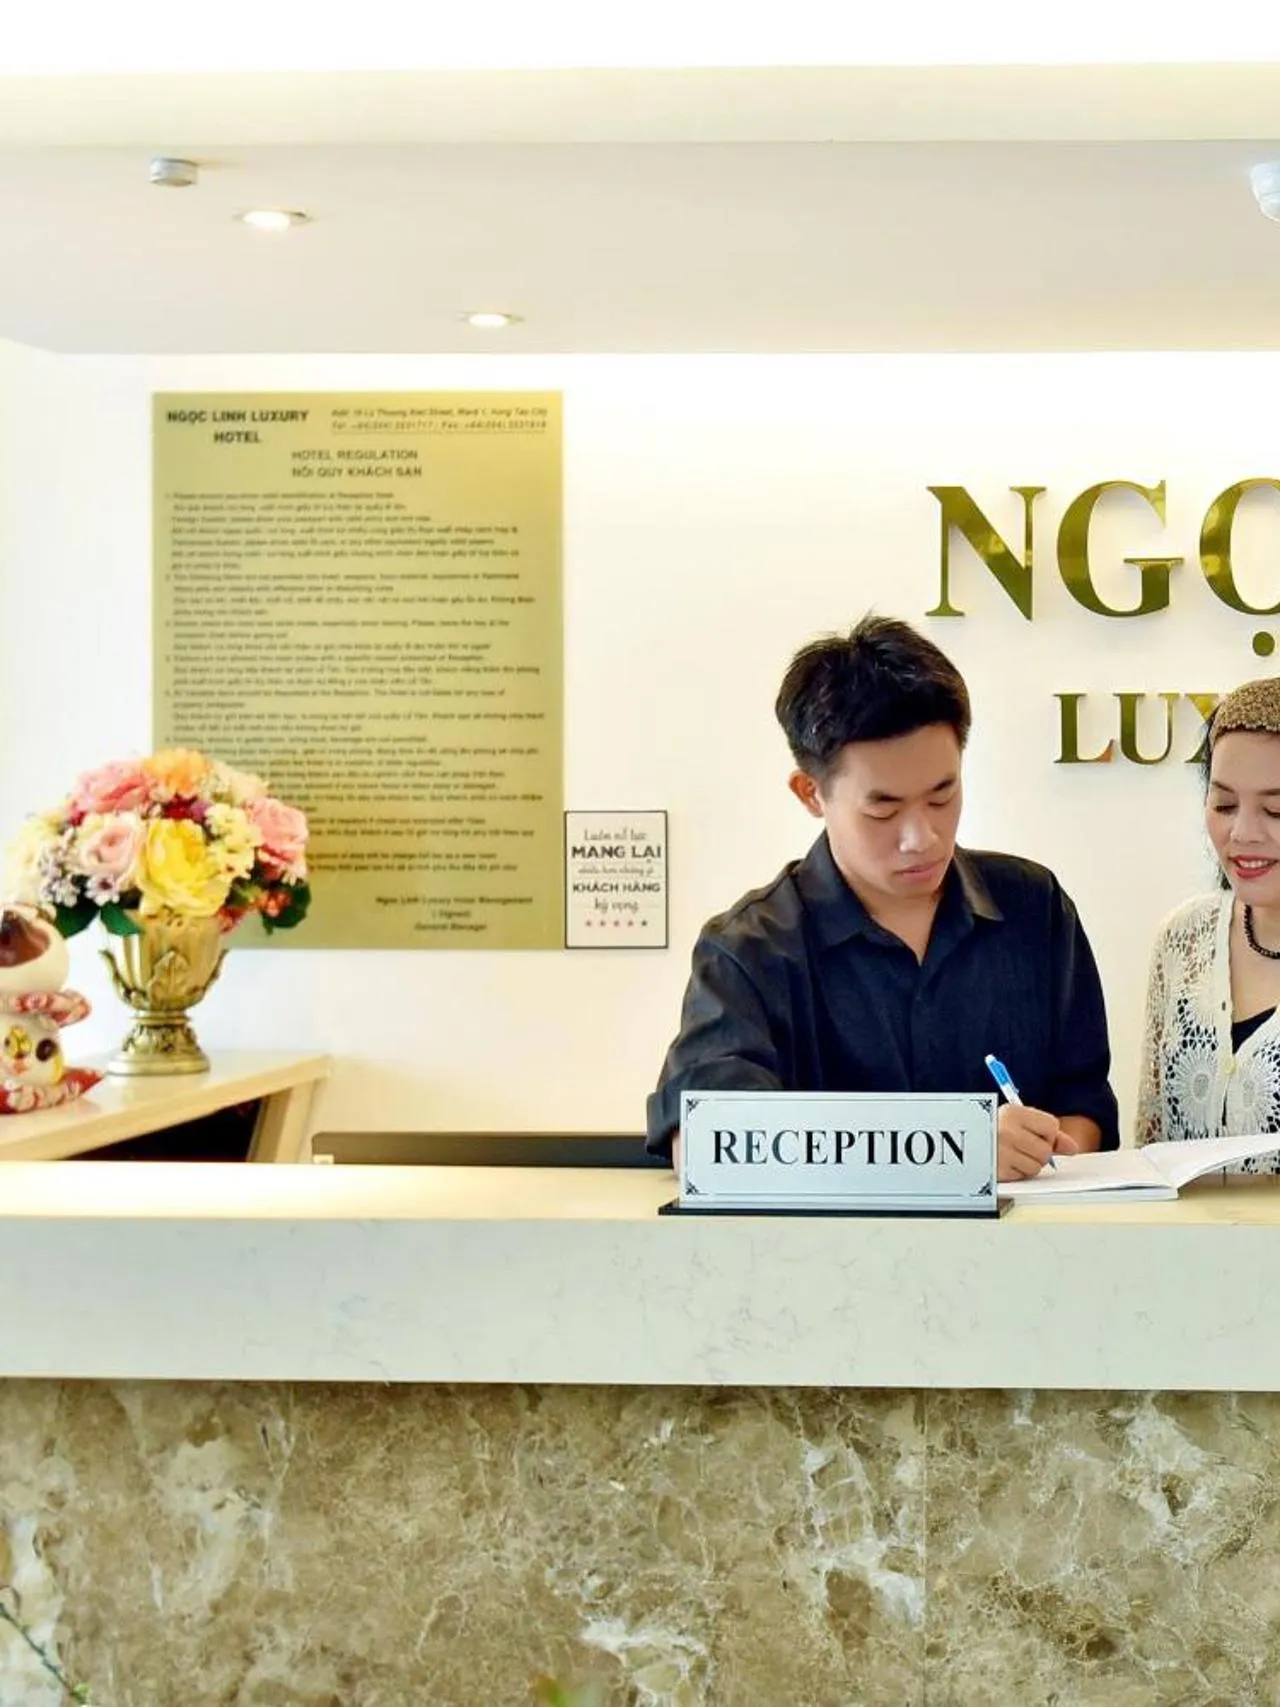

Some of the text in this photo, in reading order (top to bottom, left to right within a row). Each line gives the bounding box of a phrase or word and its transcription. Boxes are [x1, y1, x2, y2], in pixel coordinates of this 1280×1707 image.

[212, 409, 248, 423] LINH
[250, 409, 310, 423] LUXURY
[213, 430, 262, 445] HOTEL
[291, 449, 419, 462] HOTEL REGULATION
[572, 845, 662, 864] MANG LẠI
[573, 879, 619, 893] KHÁCH
[711, 1129, 966, 1166] RECEPTION
